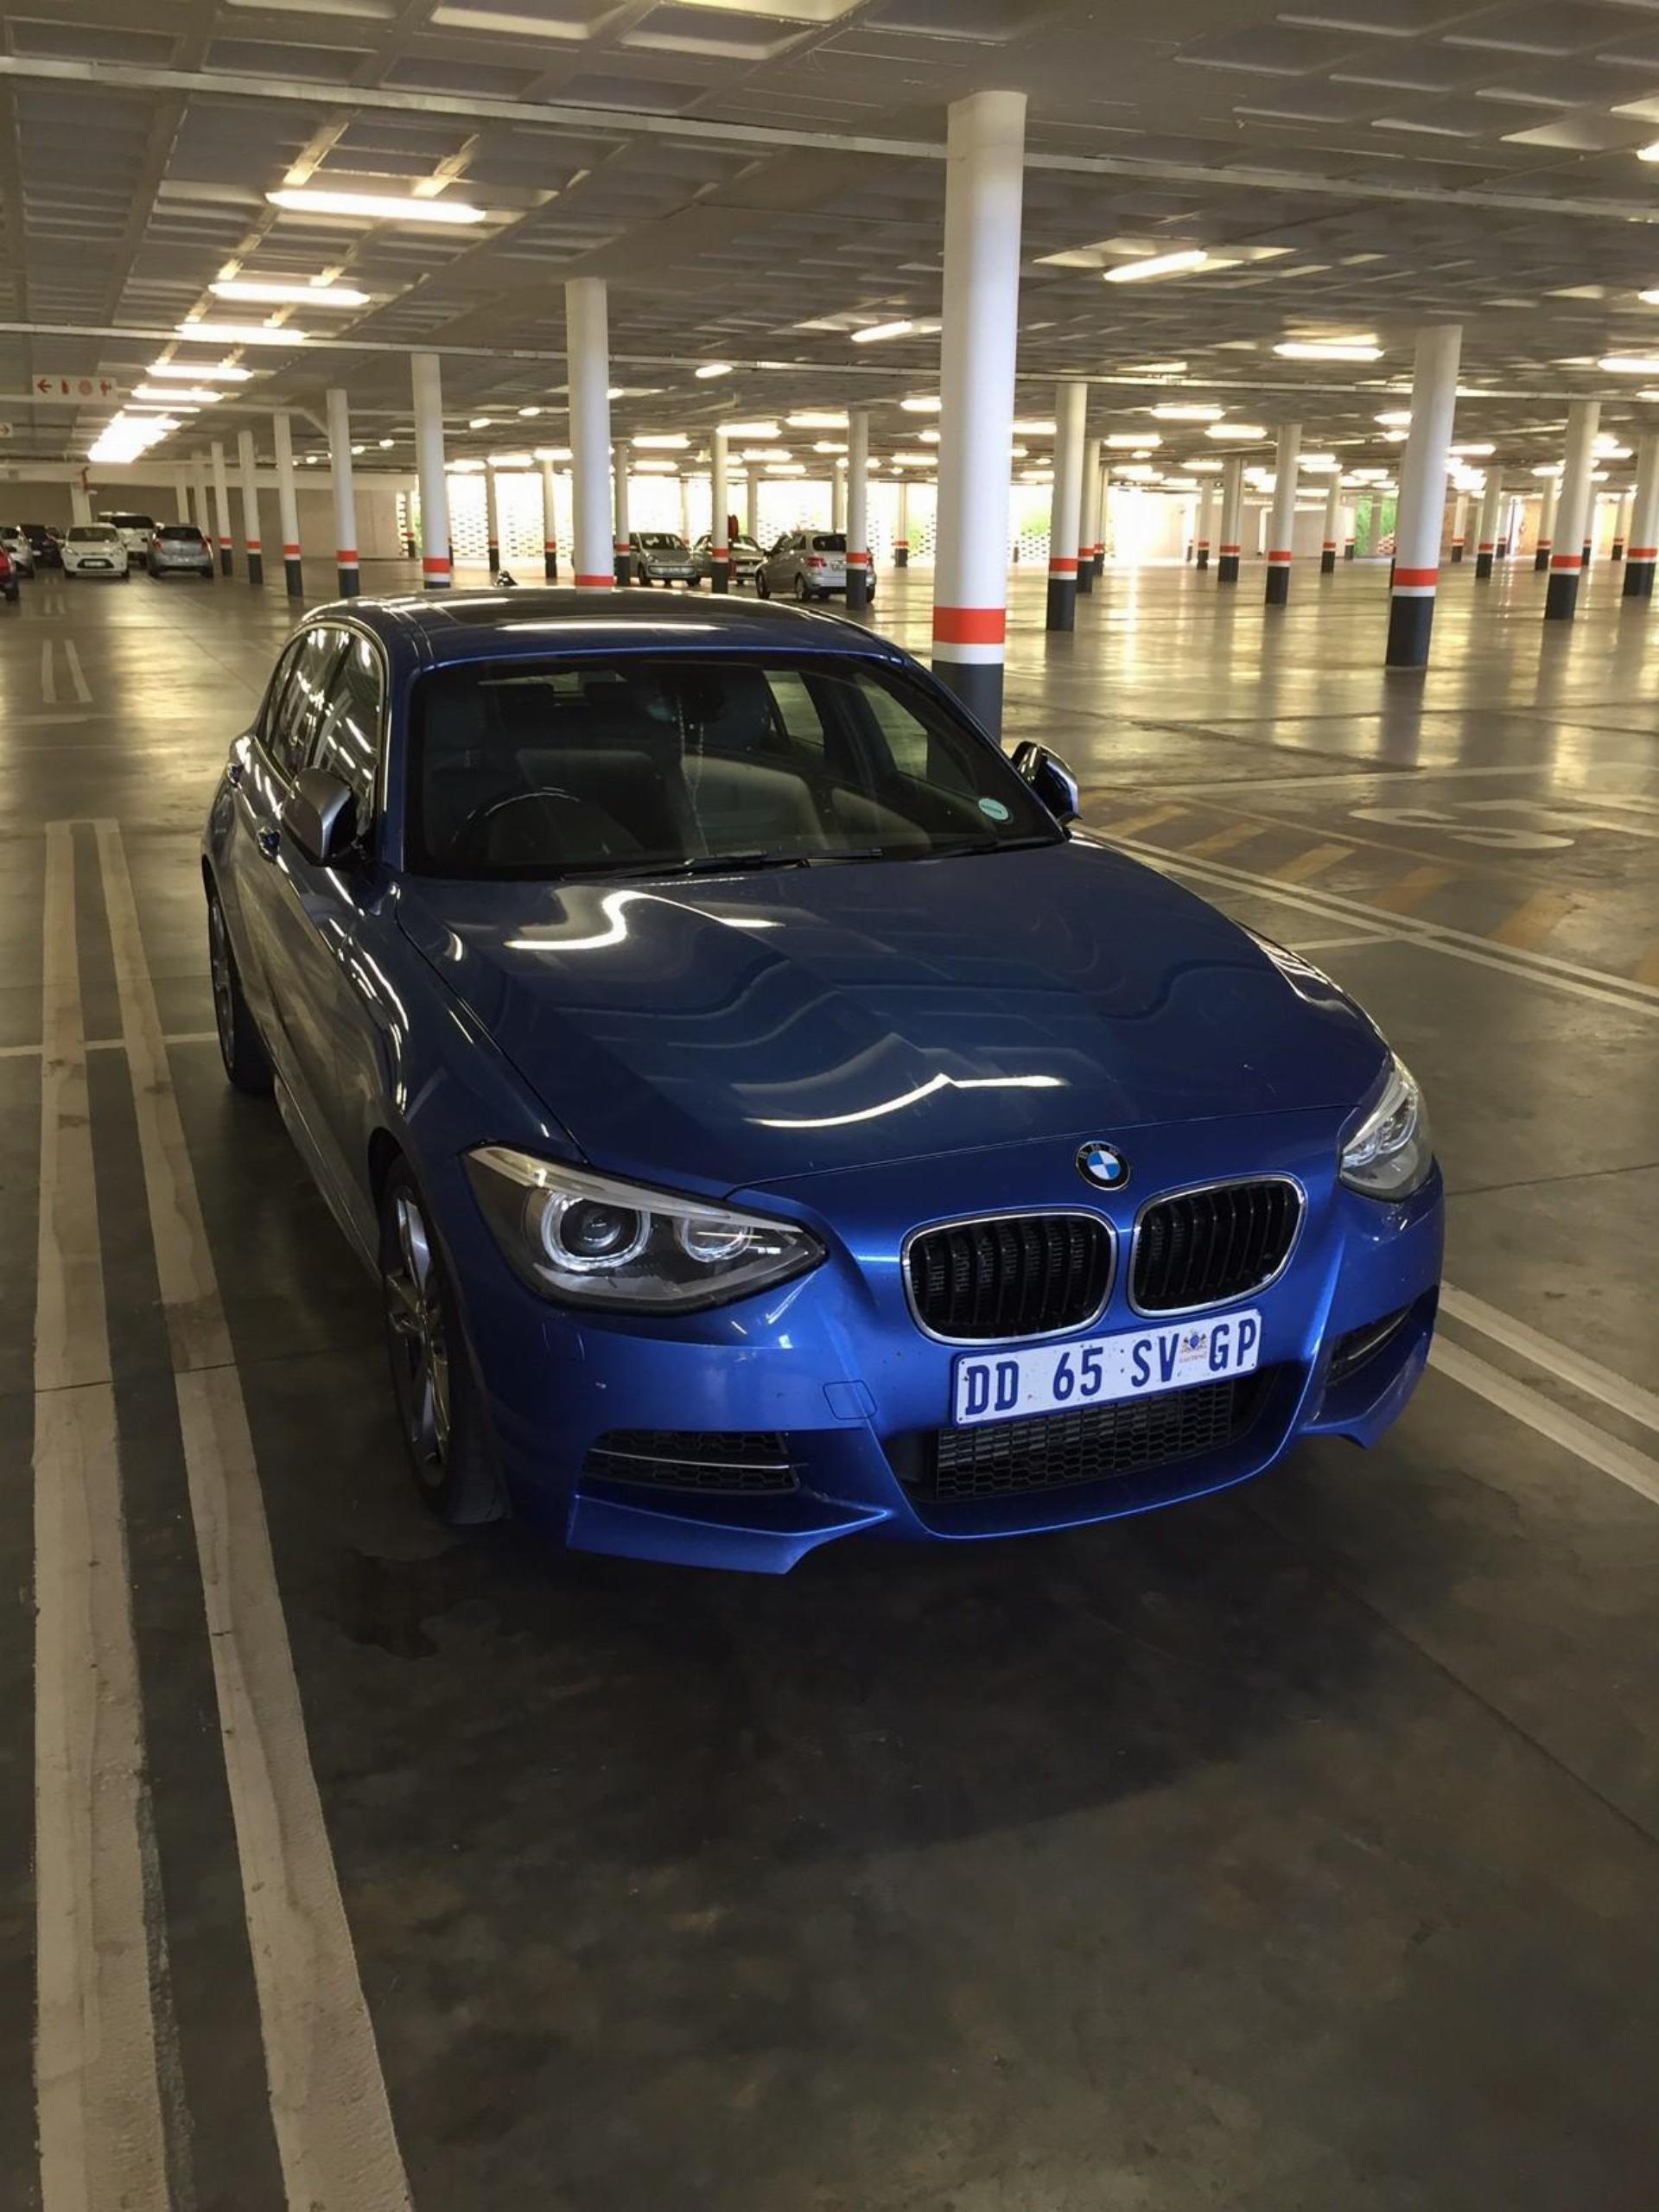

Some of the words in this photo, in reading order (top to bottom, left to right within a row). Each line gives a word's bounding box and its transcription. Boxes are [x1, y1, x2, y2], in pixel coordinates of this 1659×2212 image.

[1077, 1143, 1119, 1159] BMW
[965, 1361, 1019, 1415] DD
[1052, 1346, 1103, 1402] 65
[1131, 1333, 1179, 1388] SV
[1209, 1318, 1256, 1372] GP
